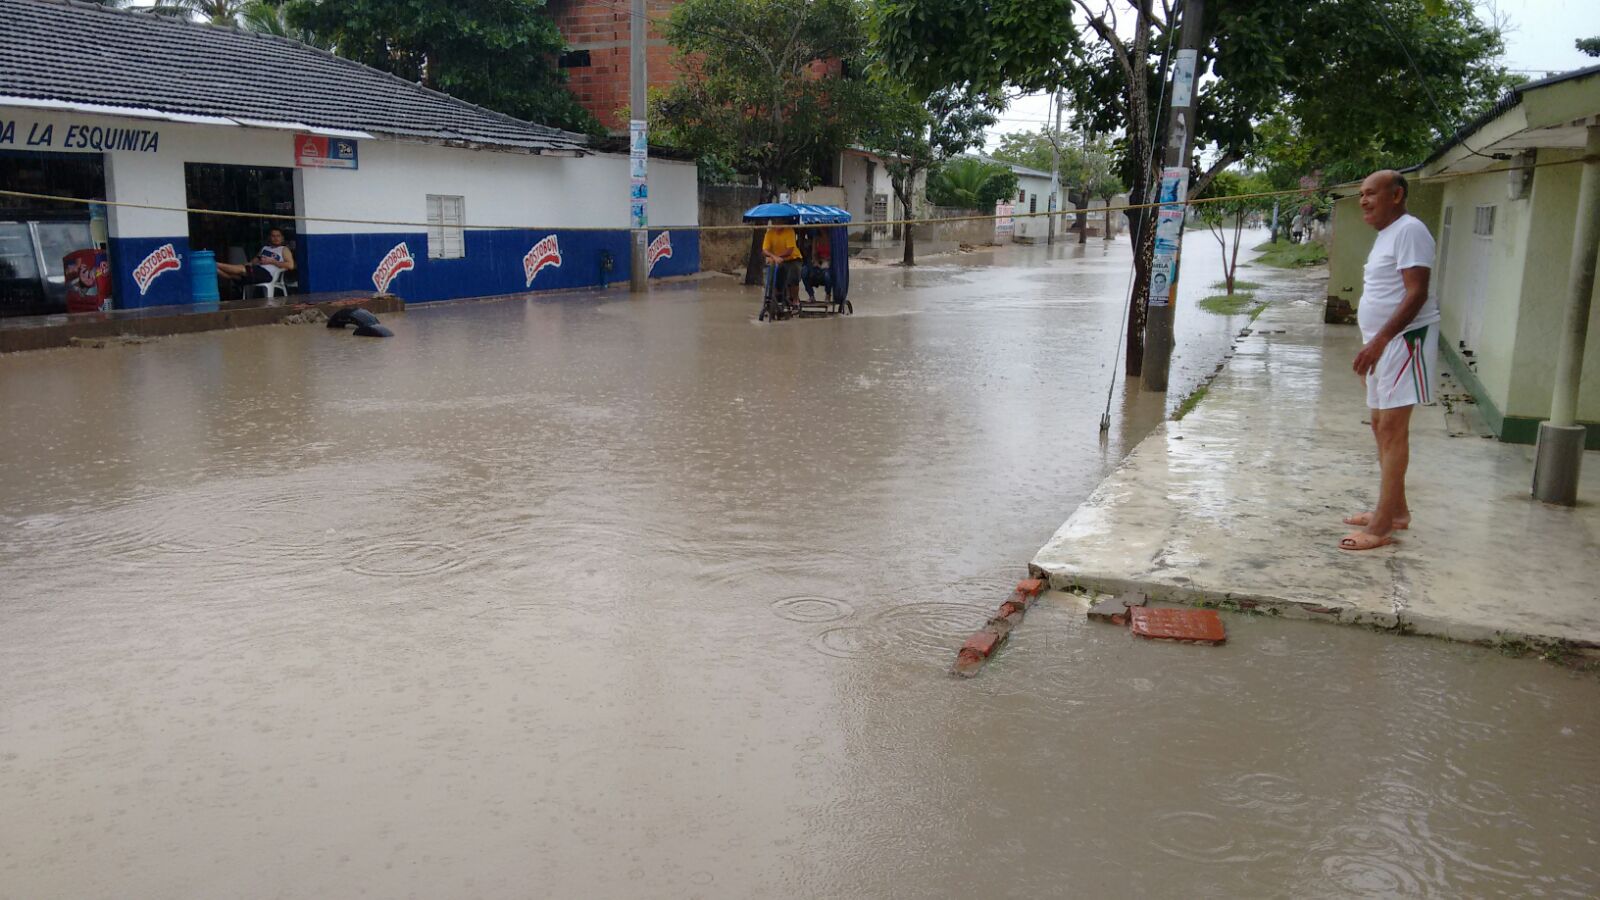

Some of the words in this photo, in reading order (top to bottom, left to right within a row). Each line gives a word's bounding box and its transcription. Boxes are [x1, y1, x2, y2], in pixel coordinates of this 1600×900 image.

[26, 122, 53, 146] LA
[64, 125, 159, 152] ESQUINITA
[134, 245, 175, 285] POSTOBON
[374, 243, 409, 290] POSTOBON
[524, 235, 558, 275] POSTOBON
